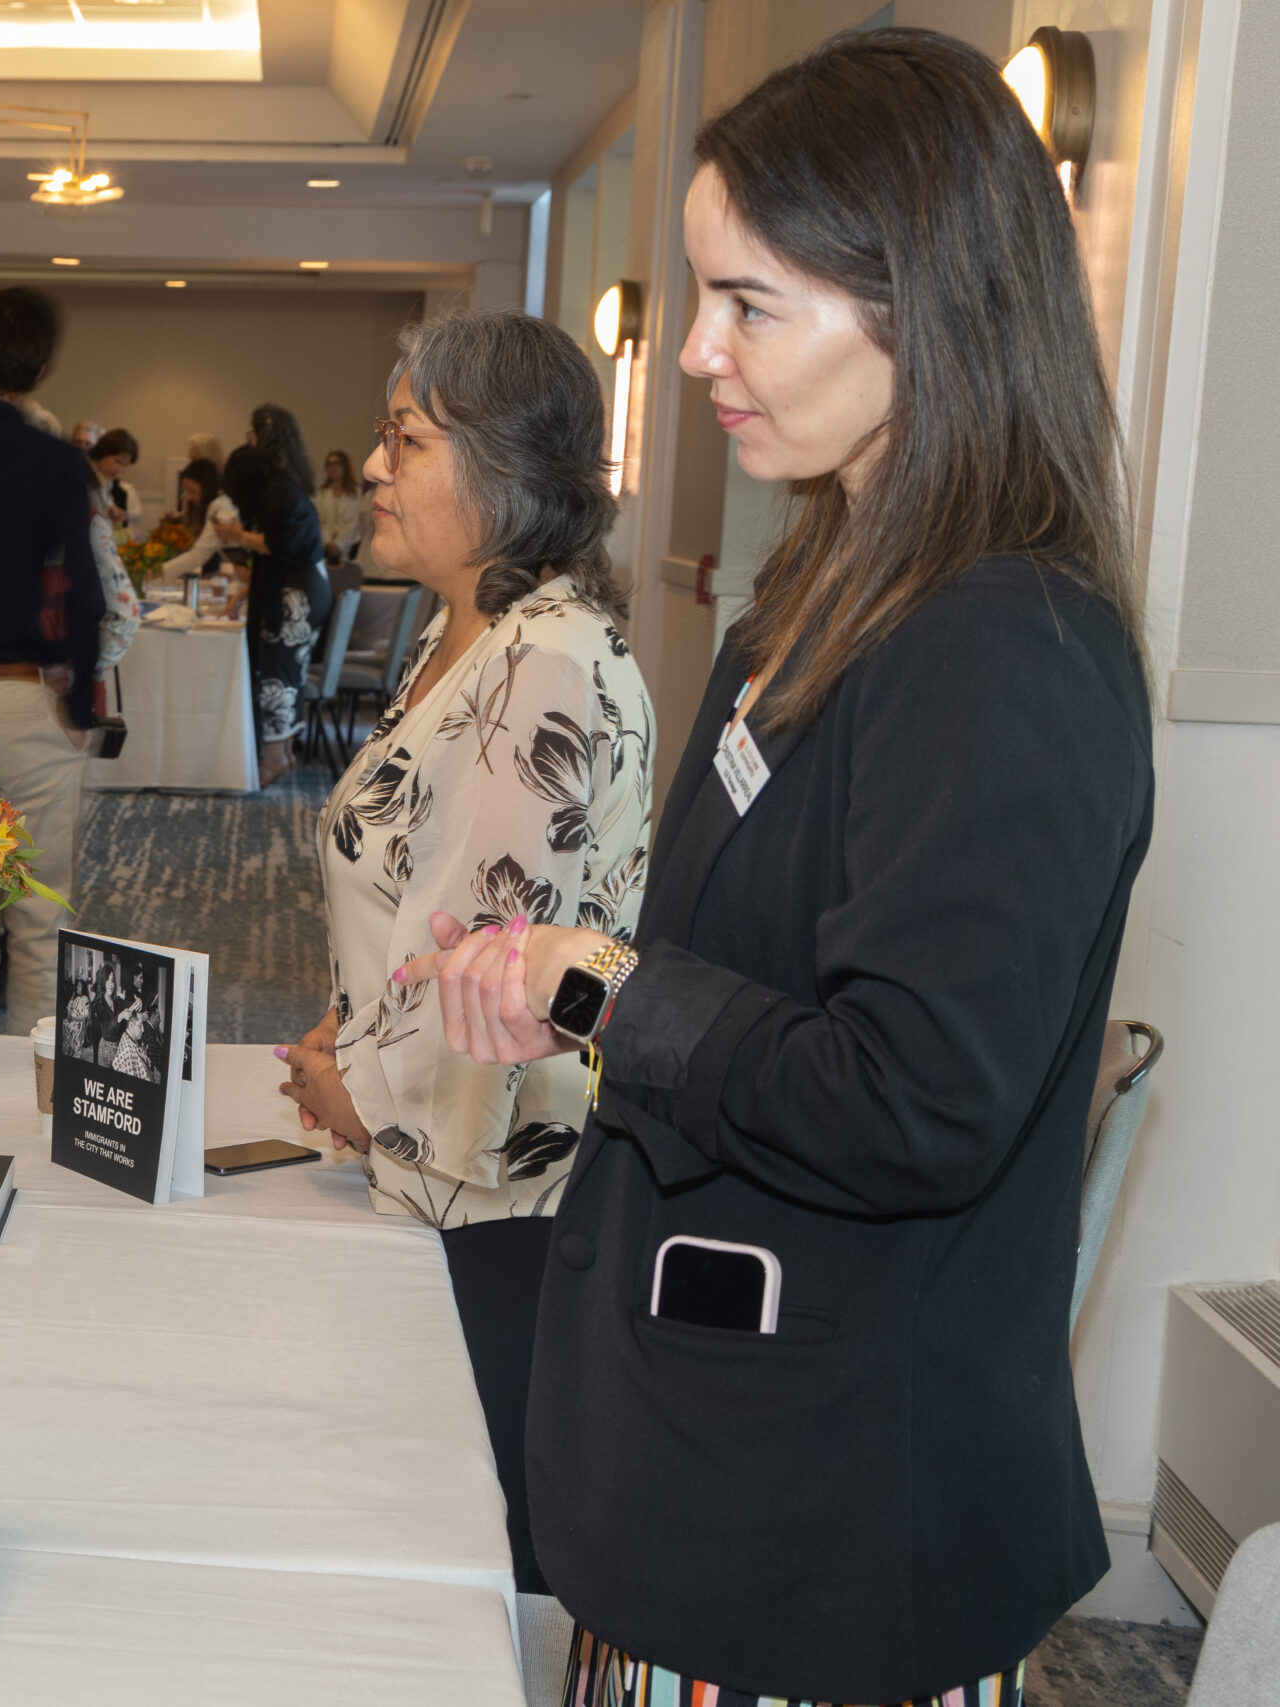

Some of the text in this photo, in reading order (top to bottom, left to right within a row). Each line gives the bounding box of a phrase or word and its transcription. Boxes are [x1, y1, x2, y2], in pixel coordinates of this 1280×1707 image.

[84, 1078, 134, 1111] WE ARE
[73, 1097, 141, 1135] STAMFORD
[74, 1137, 134, 1168] THE CITY THAT WORKS
[84, 1130, 126, 1152] IMMIGRANTS IN
